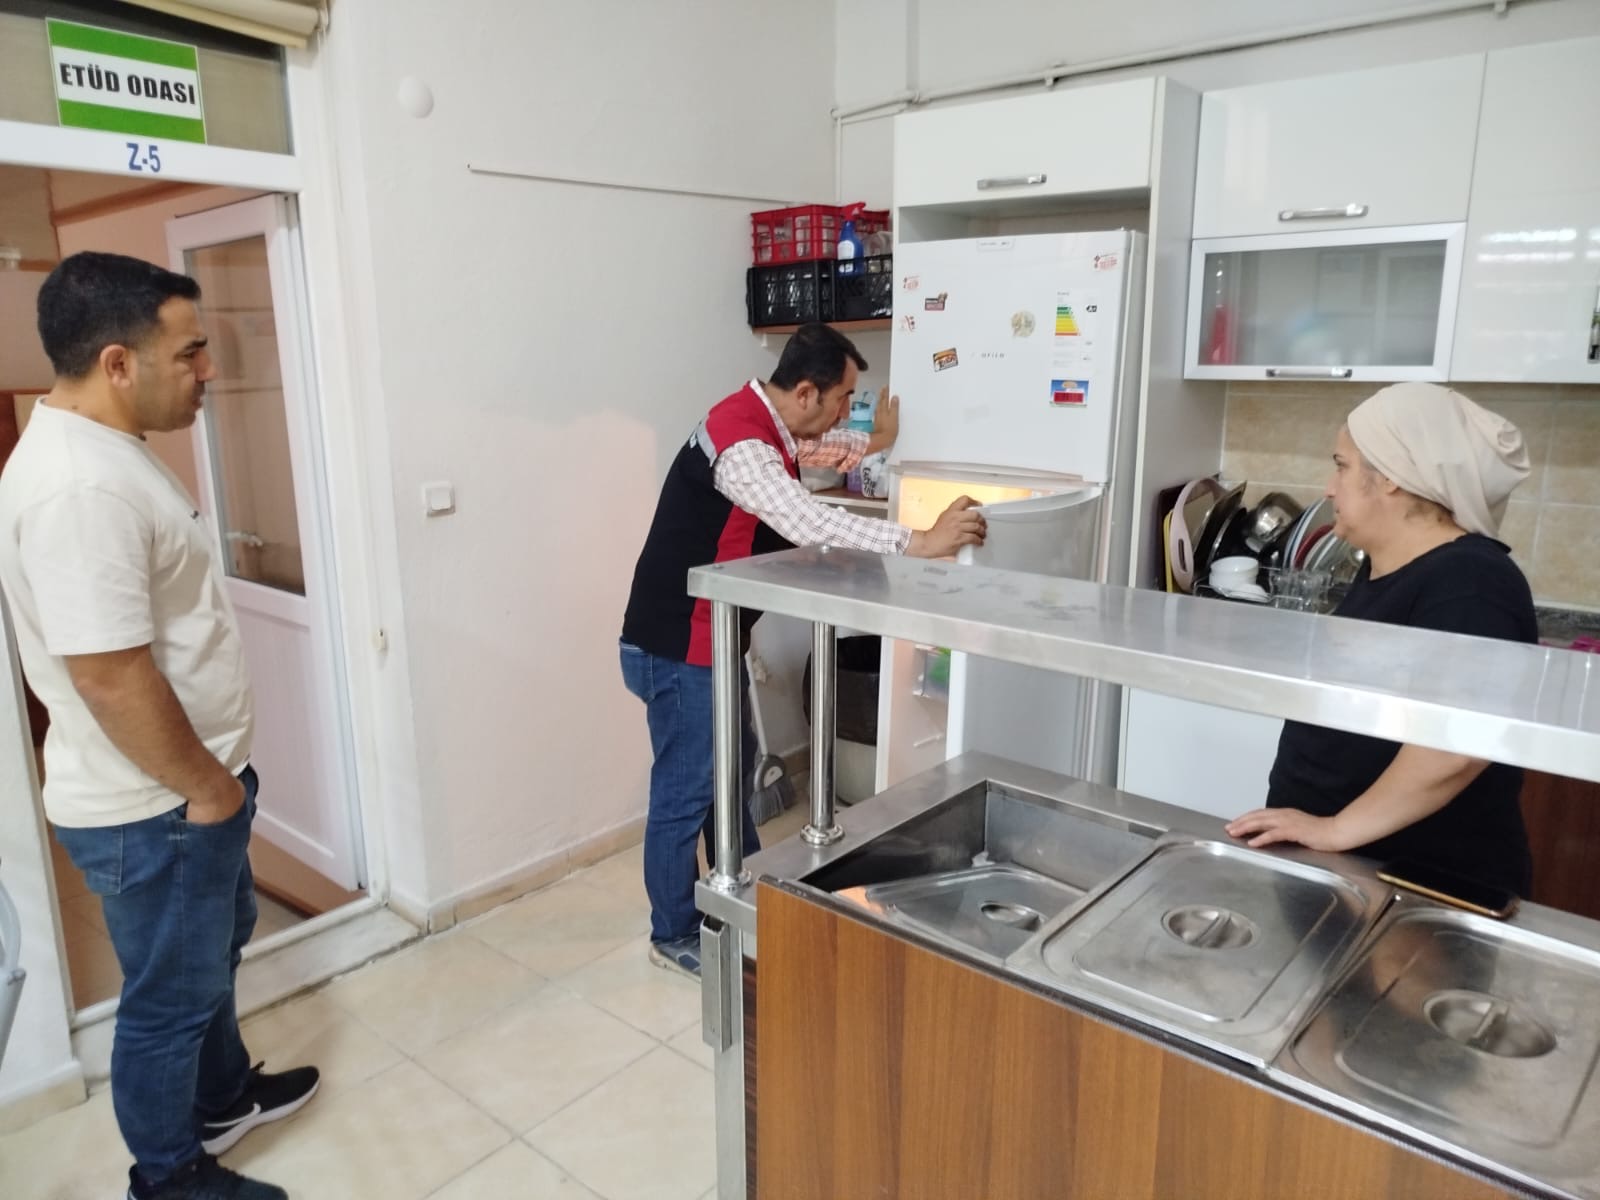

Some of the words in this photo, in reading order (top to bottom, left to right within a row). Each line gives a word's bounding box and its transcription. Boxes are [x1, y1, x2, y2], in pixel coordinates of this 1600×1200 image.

[59, 63, 120, 93] ETÜD
[127, 74, 196, 105] ODASI
[126, 142, 161, 173] Z-5
